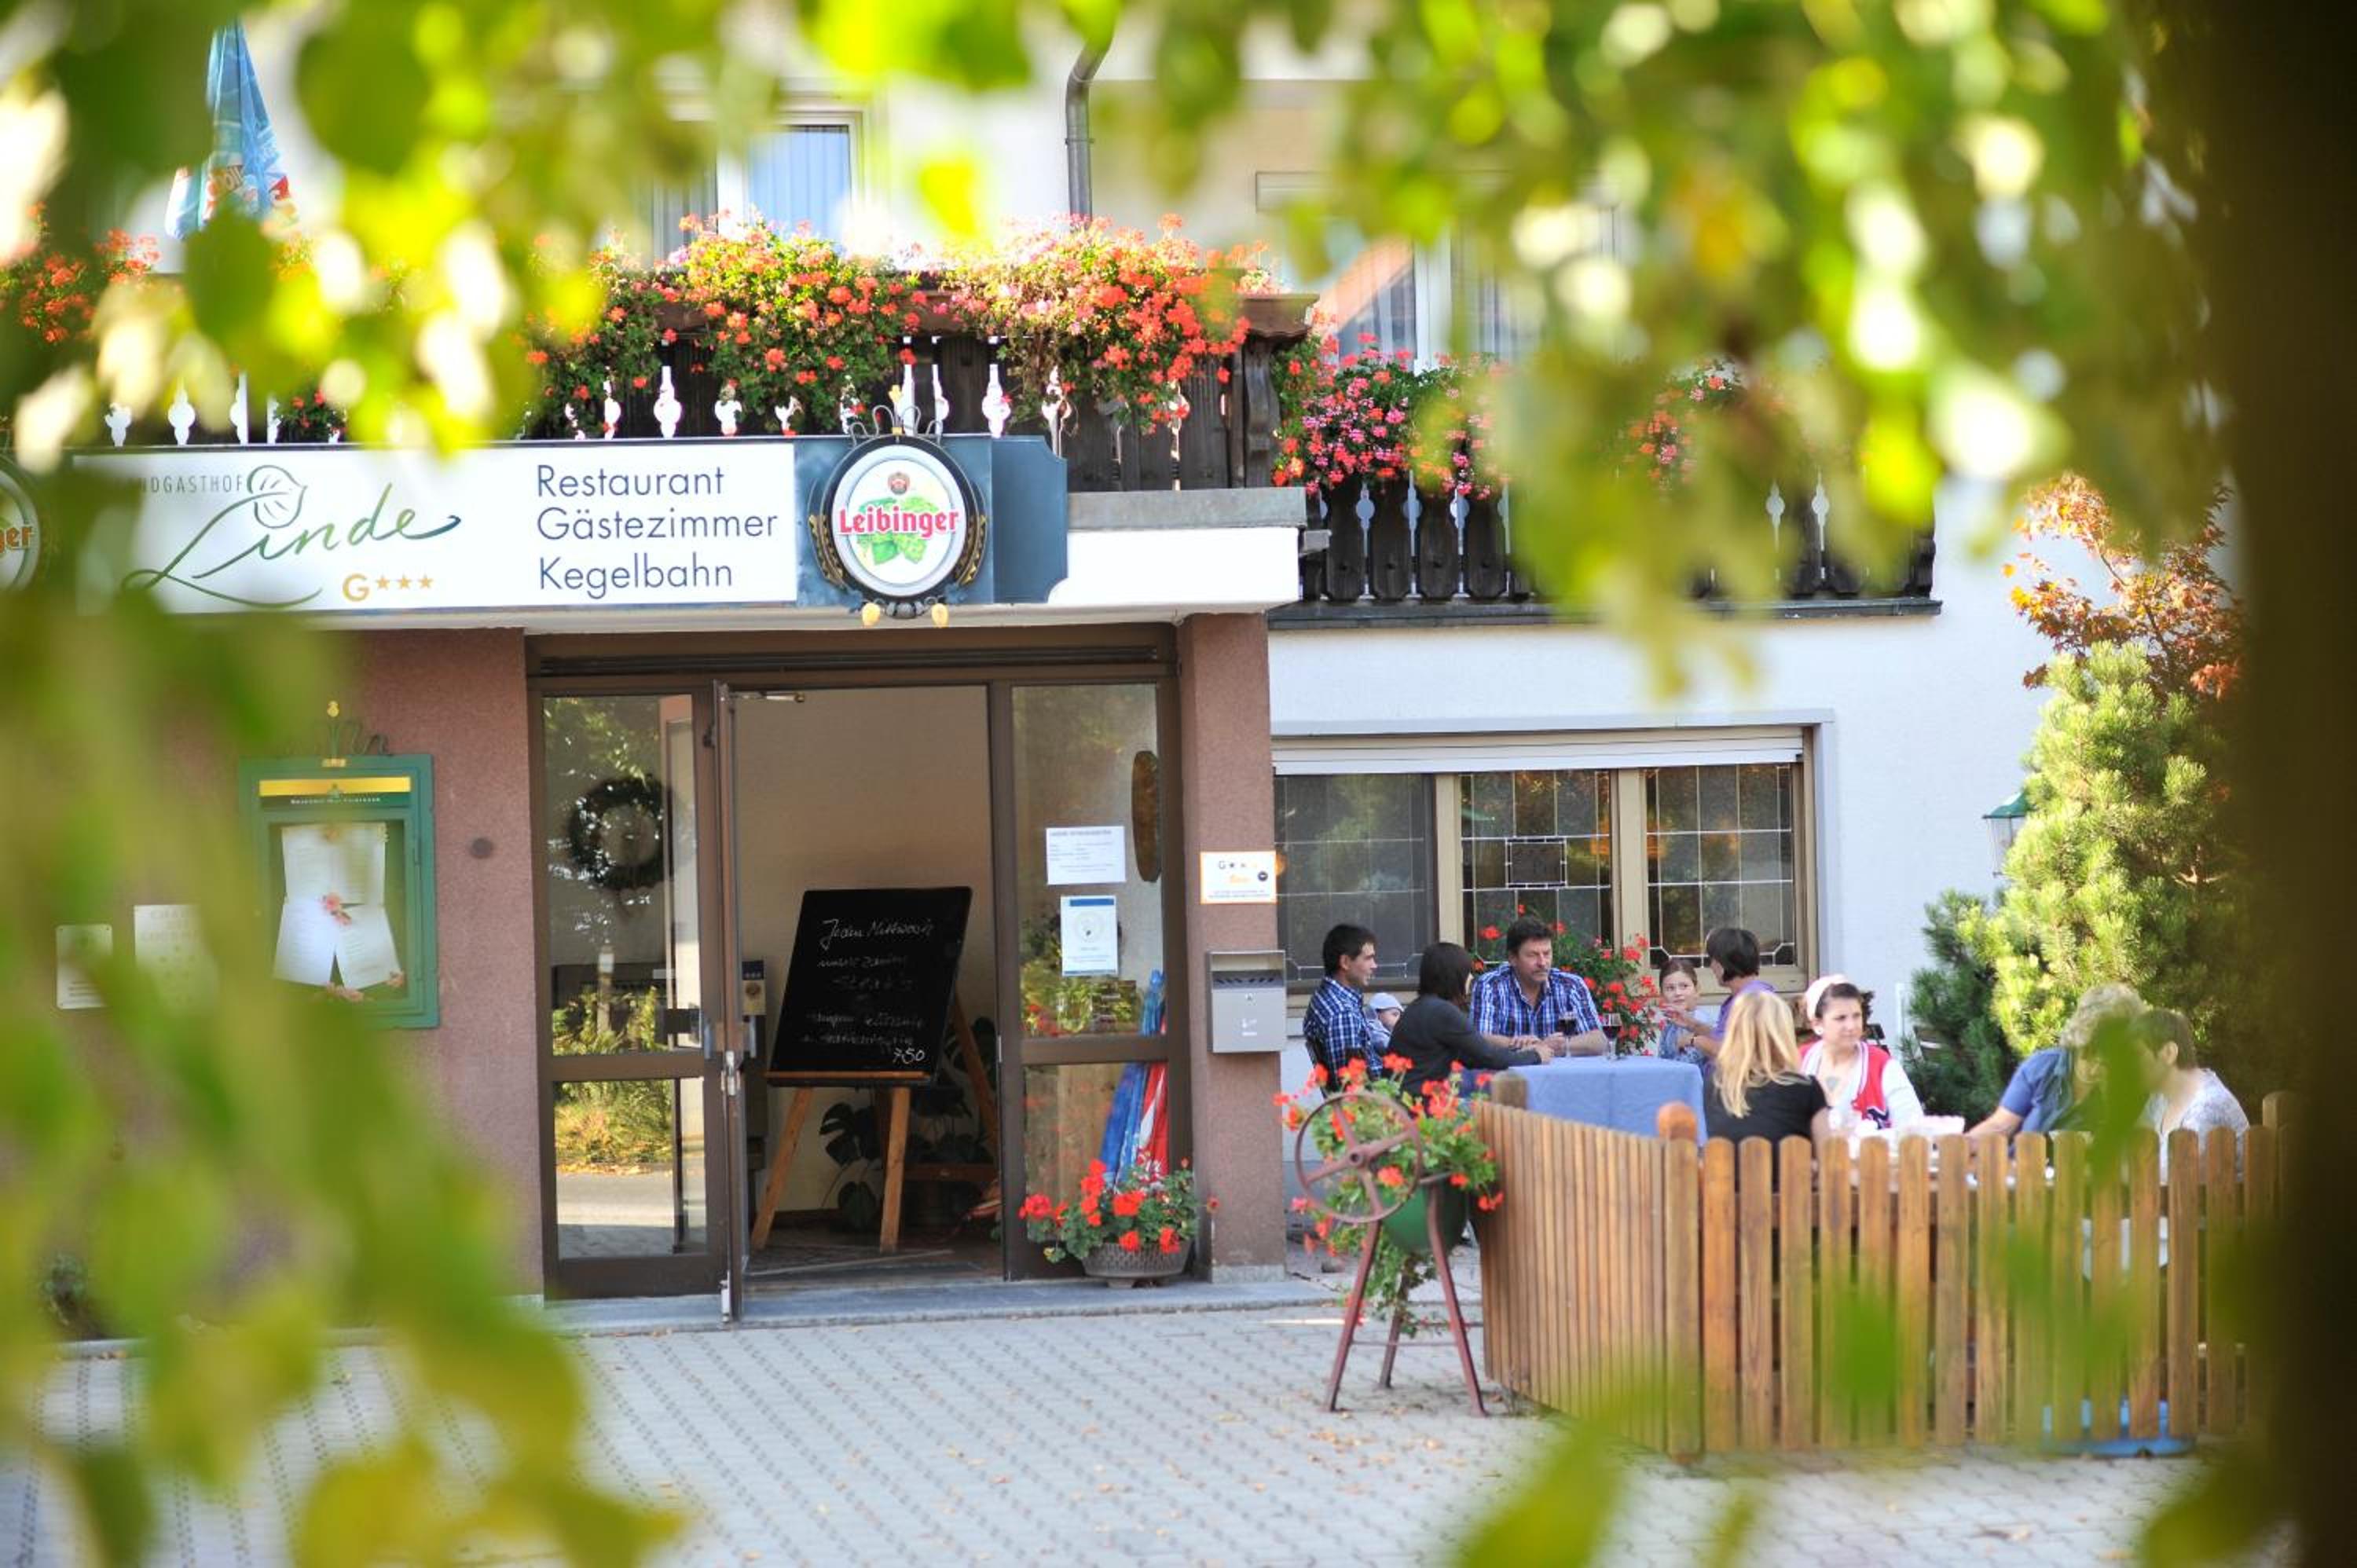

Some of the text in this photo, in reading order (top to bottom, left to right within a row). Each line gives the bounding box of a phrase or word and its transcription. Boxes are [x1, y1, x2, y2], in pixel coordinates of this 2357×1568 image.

[537, 464, 724, 497] Restaurant
[537, 507, 778, 540] Gästezimmer
[839, 505, 959, 538] Leibinger
[122, 482, 461, 608] Linde
[540, 551, 732, 599] Kegelbahn
